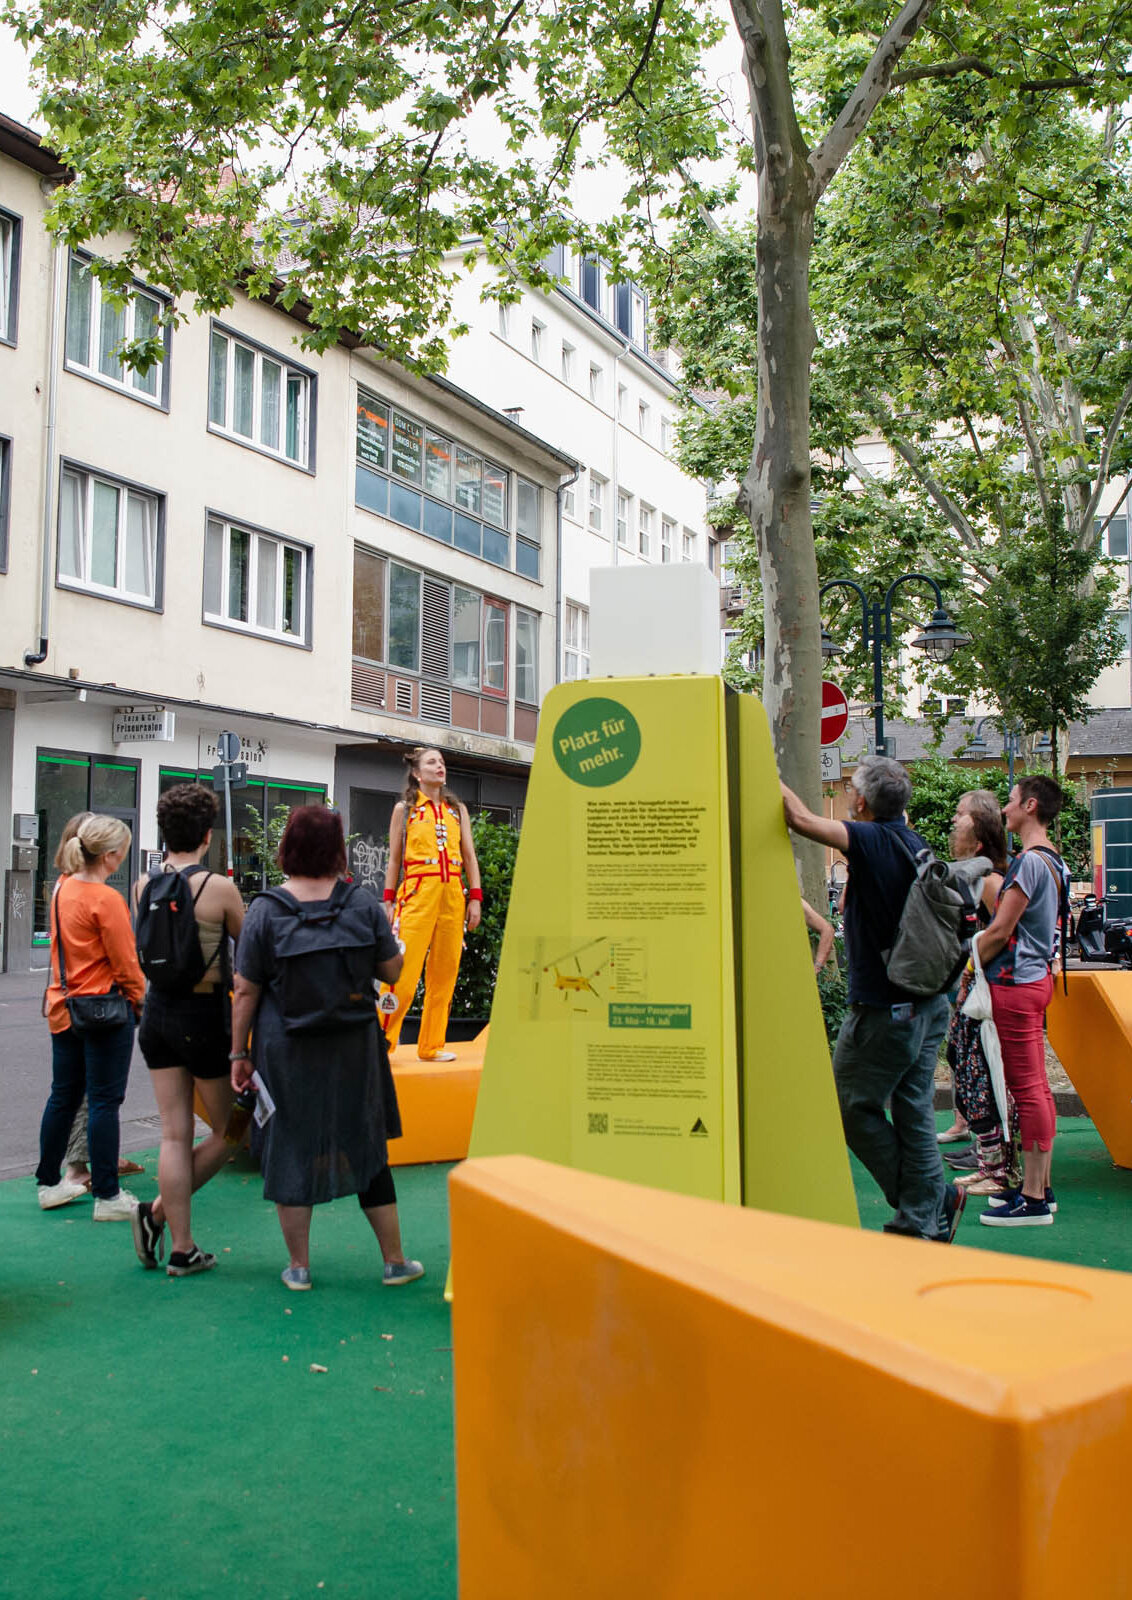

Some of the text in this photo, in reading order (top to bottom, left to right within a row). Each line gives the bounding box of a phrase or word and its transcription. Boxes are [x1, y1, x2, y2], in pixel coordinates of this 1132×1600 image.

[116, 722, 163, 732] Friseursalon
[559, 718, 626, 756] Platz für
[579, 746, 624, 774] mehr.
